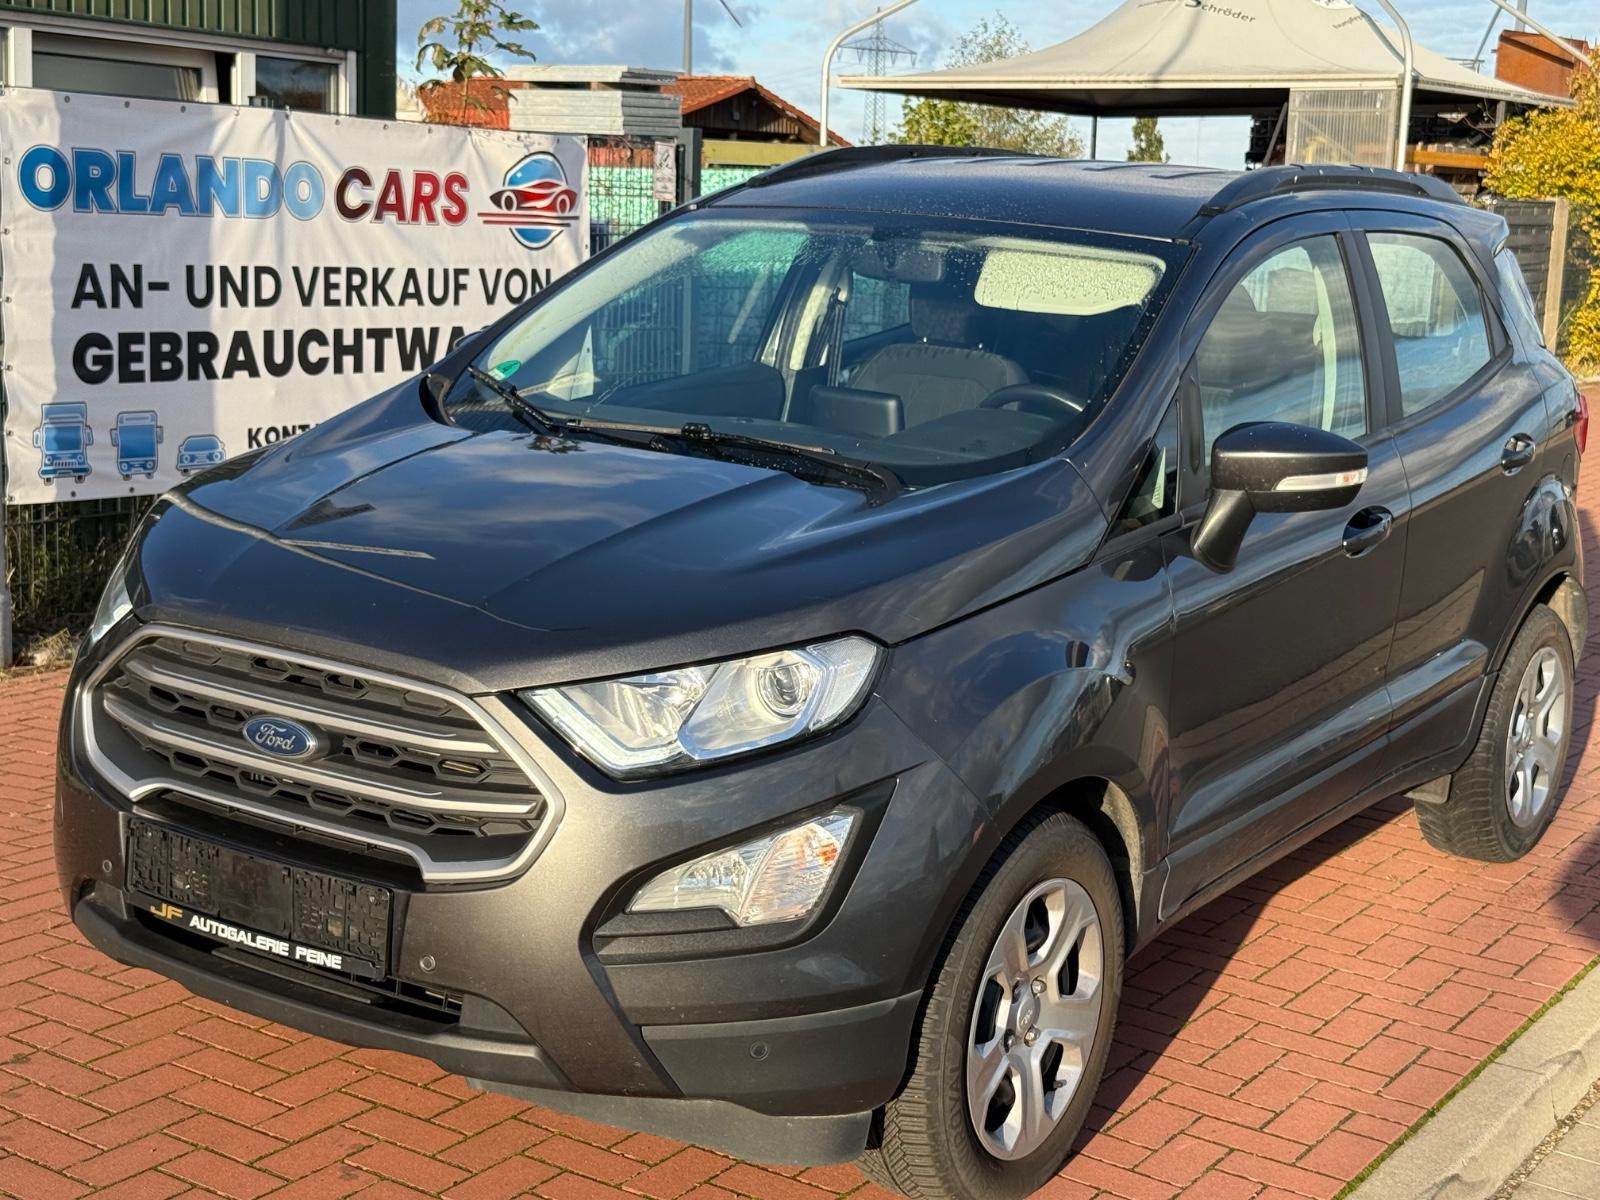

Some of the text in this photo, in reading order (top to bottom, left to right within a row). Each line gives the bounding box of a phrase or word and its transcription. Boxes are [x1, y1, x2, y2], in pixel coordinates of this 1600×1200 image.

[18, 145, 469, 226] ORLANDO CARS
[71, 263, 551, 309] AN- UND VERKAUF VON
[248, 424, 320, 449] KONT
[255, 723, 297, 750] Ford
[150, 903, 342, 970] JF AUTOGALERIE PEINE
